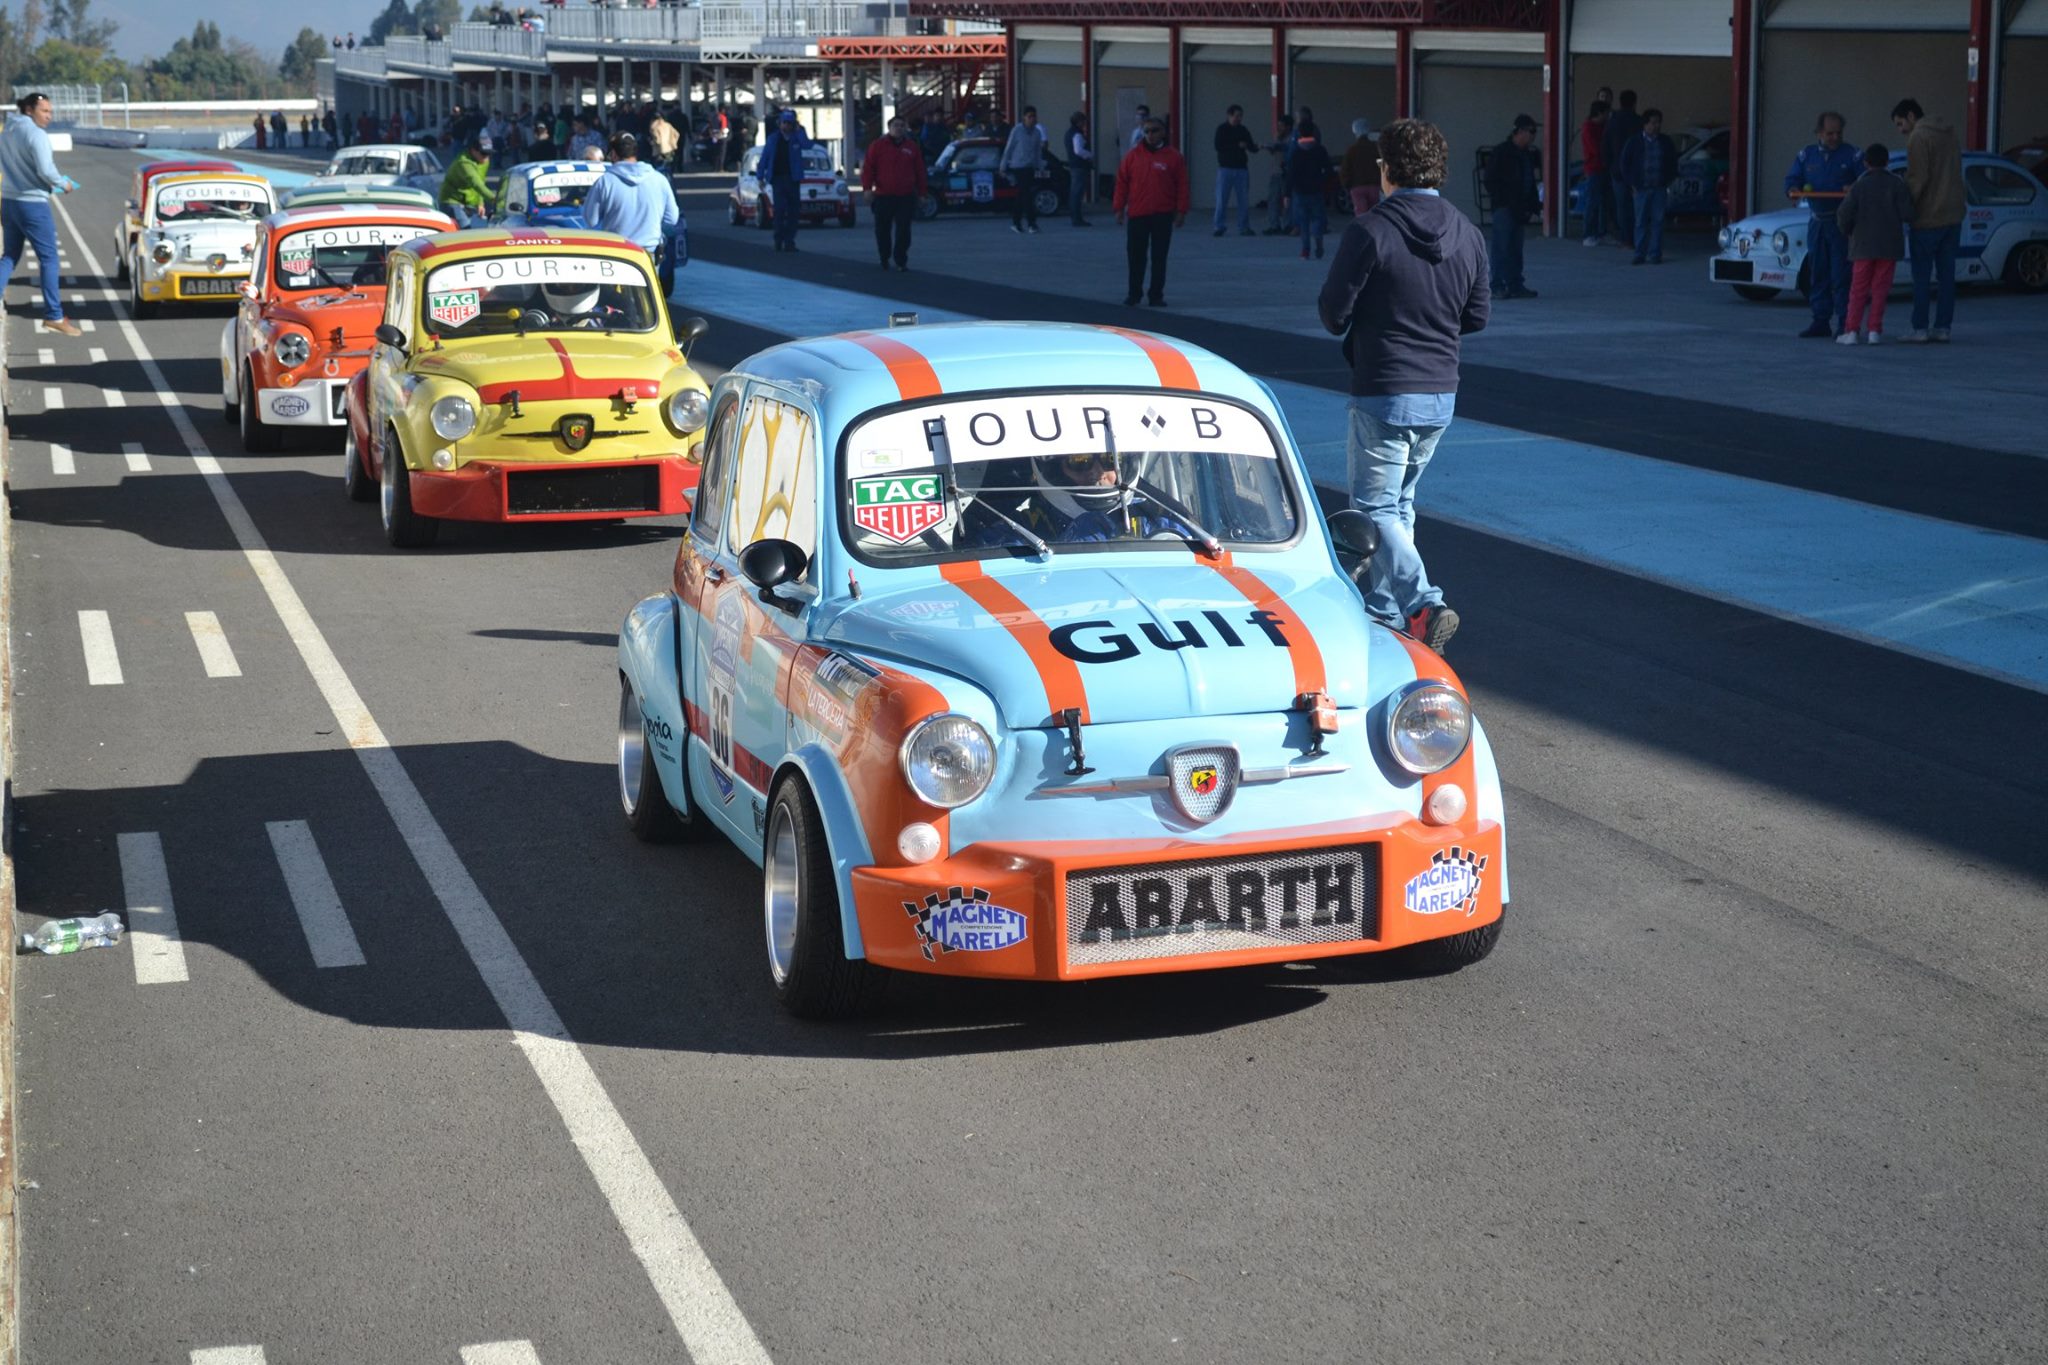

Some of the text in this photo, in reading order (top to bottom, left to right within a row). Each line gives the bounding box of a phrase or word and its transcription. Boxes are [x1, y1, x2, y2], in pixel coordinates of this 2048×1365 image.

[175, 188, 250, 198] FOUR B
[976, 184, 991, 196] 35
[304, 230, 382, 247] FOUR
[284, 251, 312, 260] TAG
[462, 259, 615, 282] FOUR B
[185, 281, 243, 295] ABART
[435, 294, 474, 306] TAG
[434, 305, 476, 324] HEUER
[922, 405, 1223, 452] FOUR B
[861, 478, 936, 502] TAG
[859, 504, 942, 539] HEUER
[1048, 610, 1291, 664] Gulf
[712, 686, 729, 768] 36
